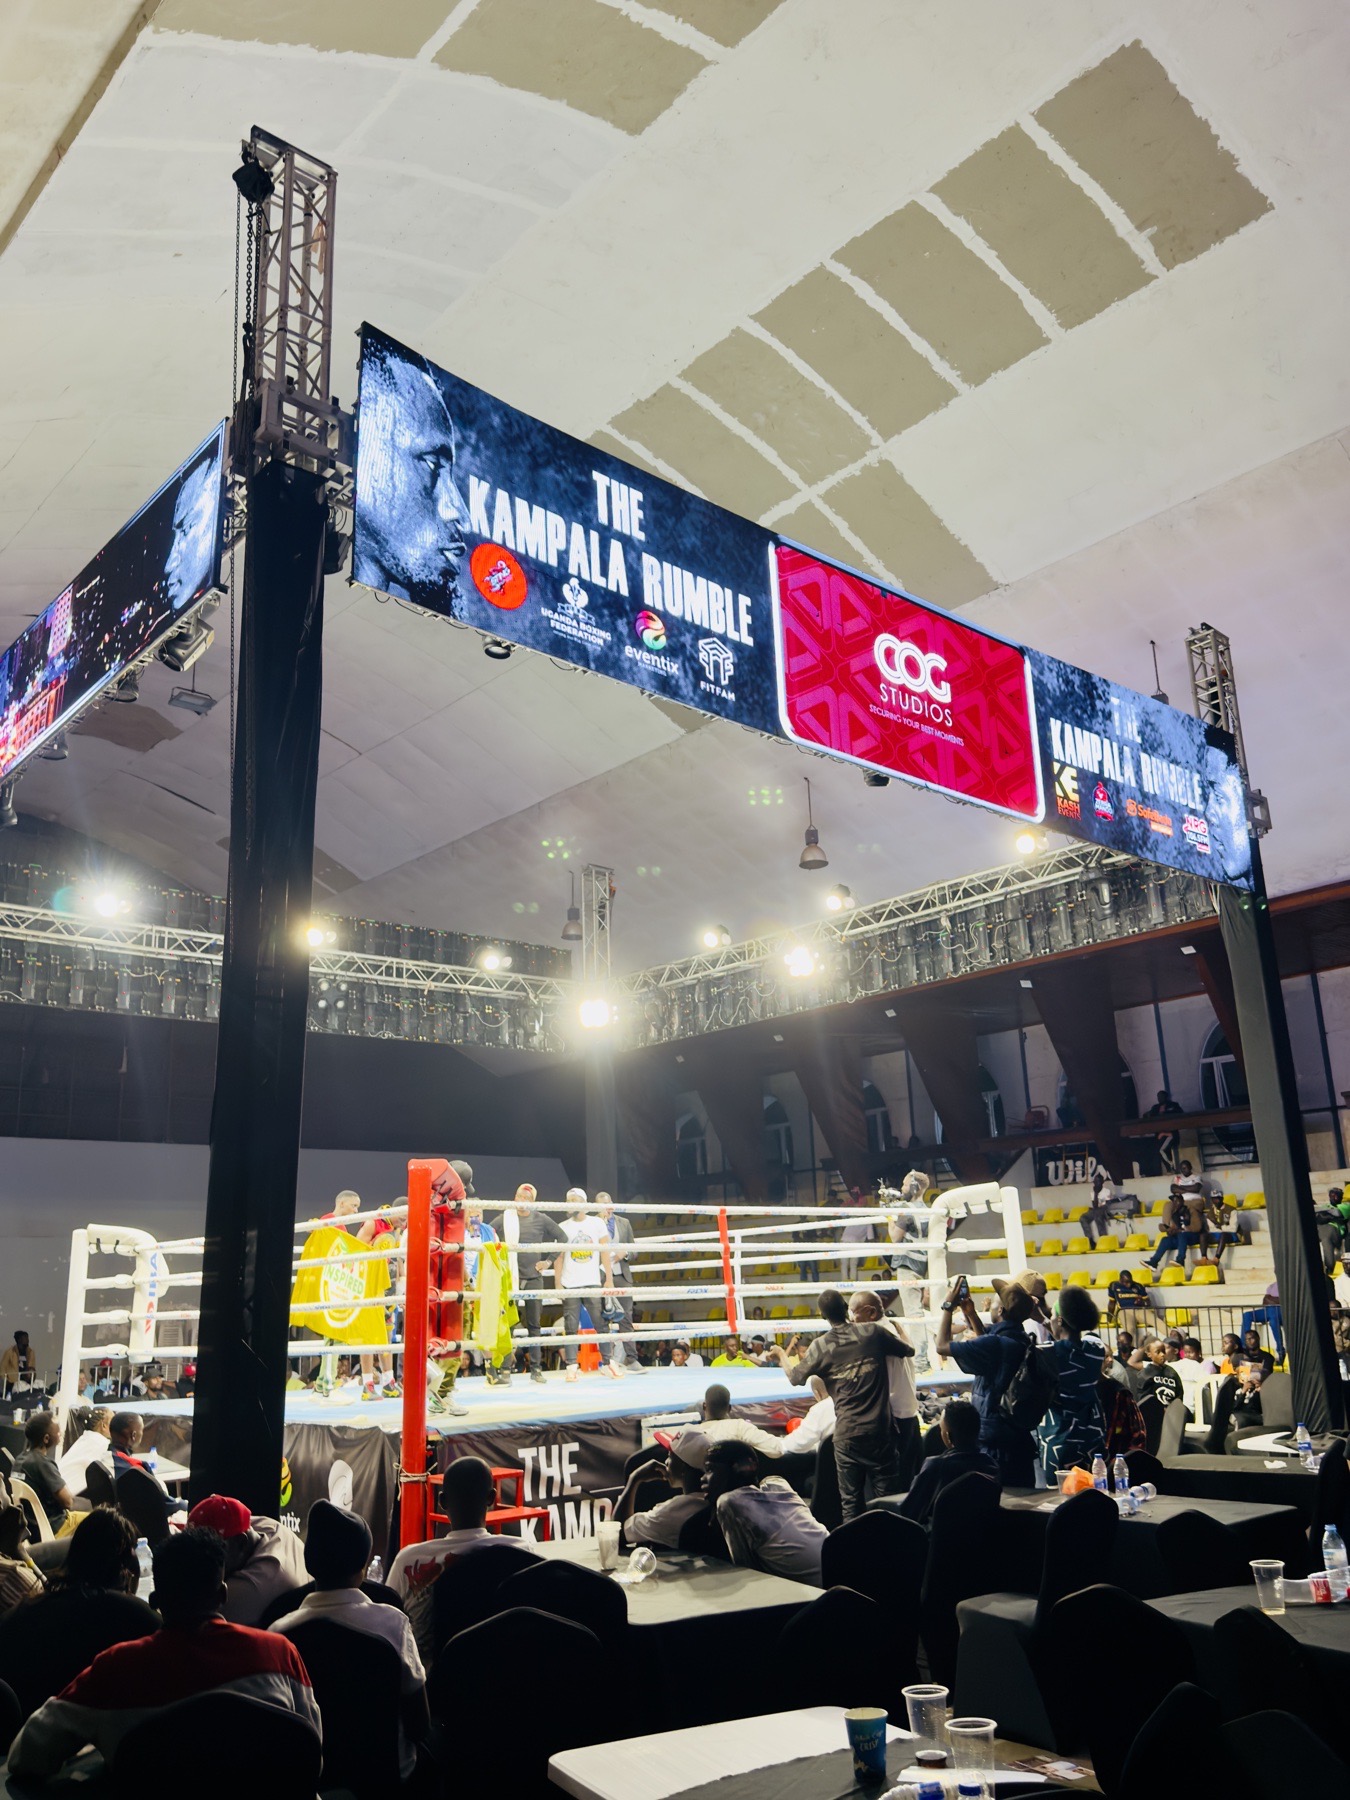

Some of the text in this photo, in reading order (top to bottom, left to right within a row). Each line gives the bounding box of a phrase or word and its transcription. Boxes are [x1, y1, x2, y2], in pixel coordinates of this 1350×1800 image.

[592, 469, 646, 541] THE
[469, 474, 754, 647] KAMPALA RUMBLE
[541, 607, 579, 628] UGANDA
[579, 620, 612, 641] BOXING
[550, 619, 604, 646] FEDERATION
[624, 644, 679, 675] eventix
[873, 632, 952, 704] COG
[700, 681, 736, 702] FITFAM
[879, 682, 953, 727] STUDIOS
[869, 703, 964, 746] SECURING YOUR BEST MOMENTS
[1110, 696, 1142, 743] THE
[1050, 717, 1205, 812] KAMPALA RUMBLE
[1057, 796, 1080, 812] KASH
[1058, 809, 1082, 822] EVENTS
[323, 1264, 364, 1296] INSPIRED
[1153, 1375, 1176, 1388] GUCCI
[517, 1442, 582, 1502] THE
[520, 1497, 613, 1543] KAMP
